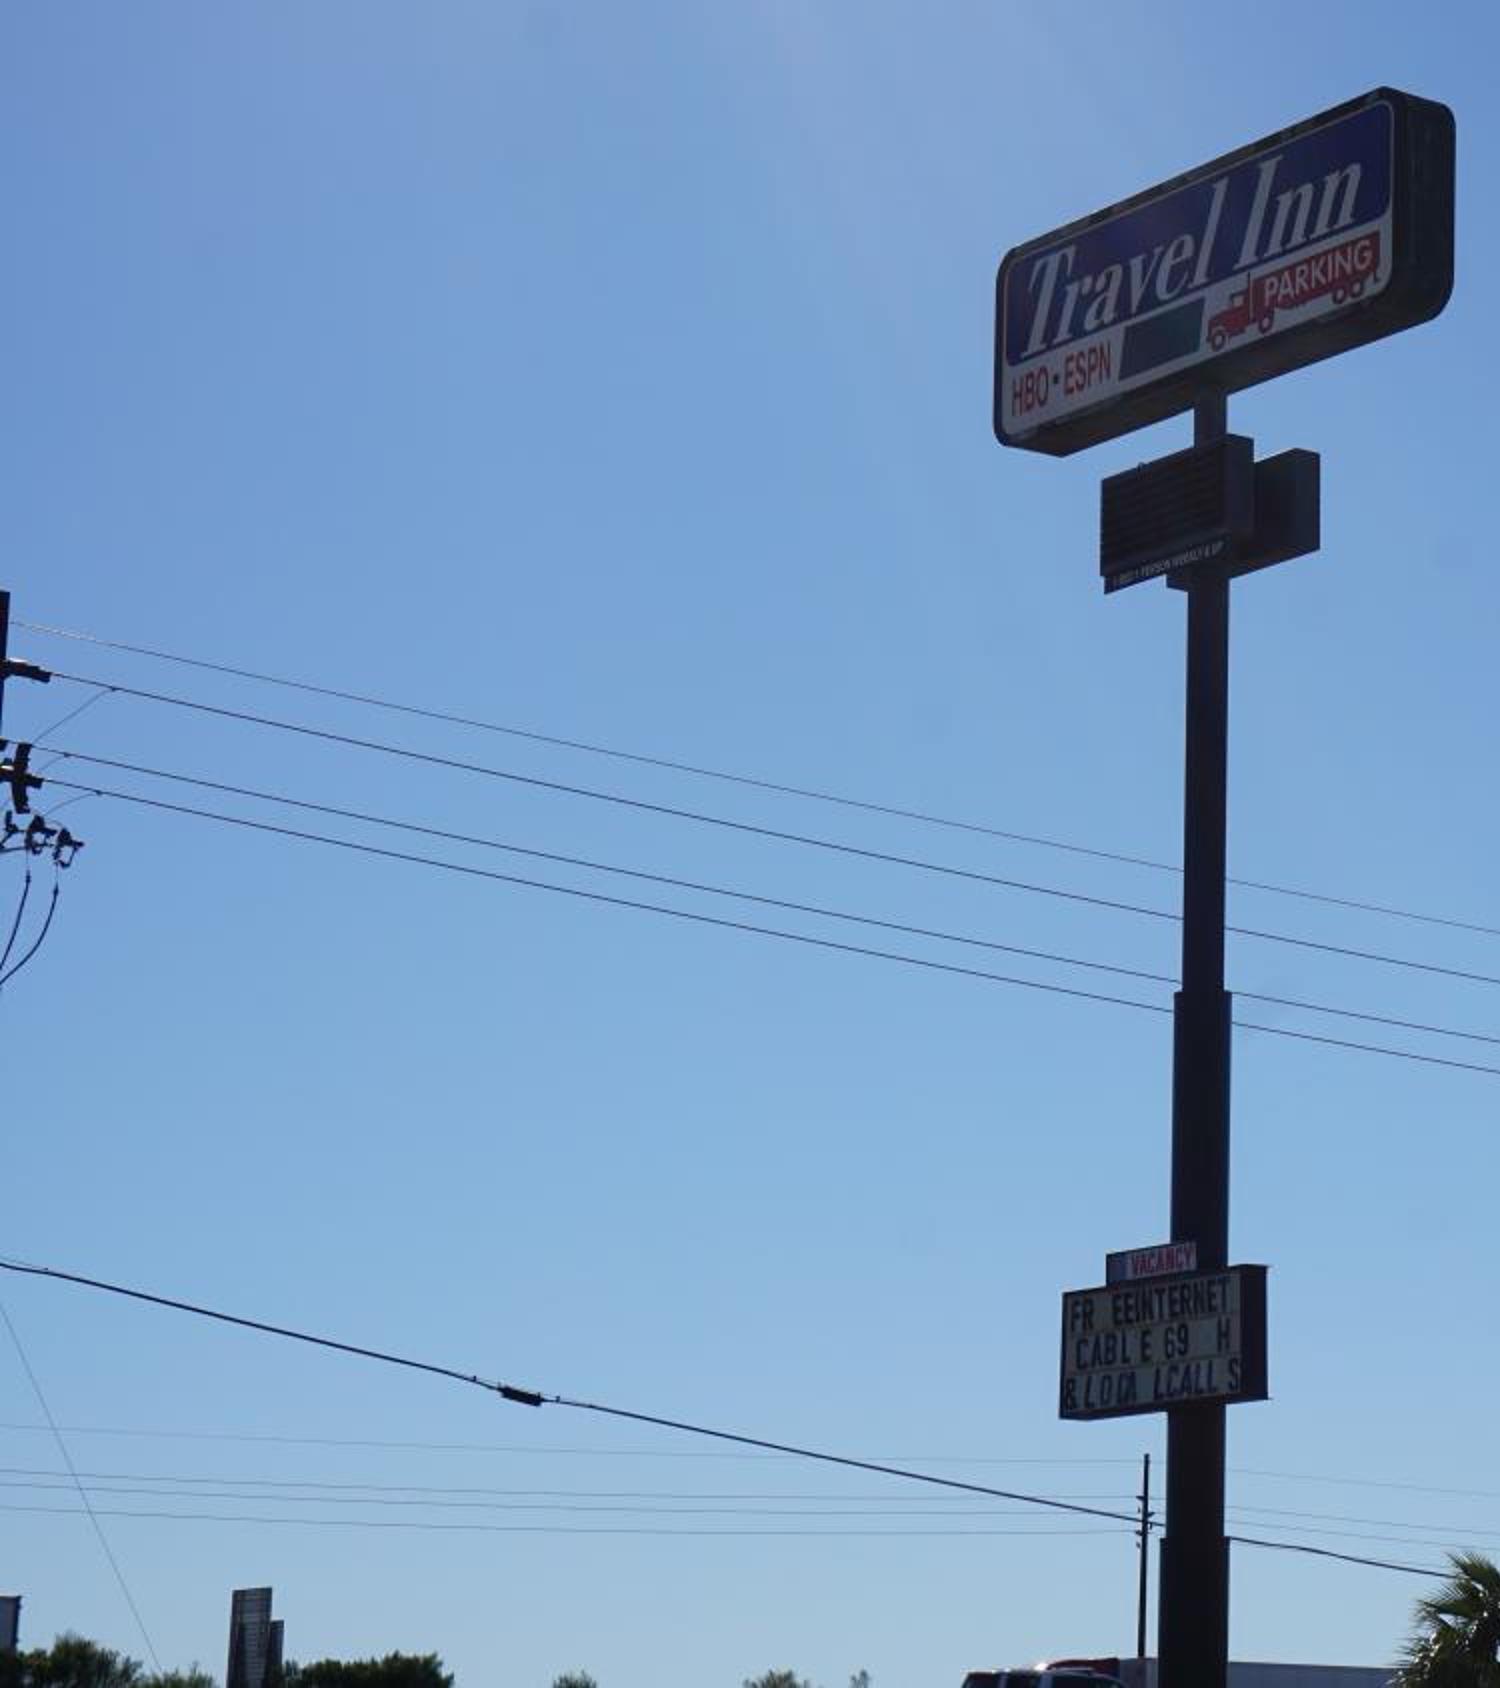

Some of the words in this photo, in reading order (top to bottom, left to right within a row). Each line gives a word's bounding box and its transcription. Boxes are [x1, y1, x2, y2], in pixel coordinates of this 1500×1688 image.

[1020, 178, 1228, 359] Travel
[1234, 155, 1363, 272] Inn
[1264, 239, 1374, 307] PARKING
[1011, 374, 1050, 417] HBO
[1063, 341, 1112, 396] ESPN
[1132, 1246, 1193, 1276] VACANCY
[1164, 1324, 1189, 1359] 69
[1217, 1318, 1231, 1353] H
